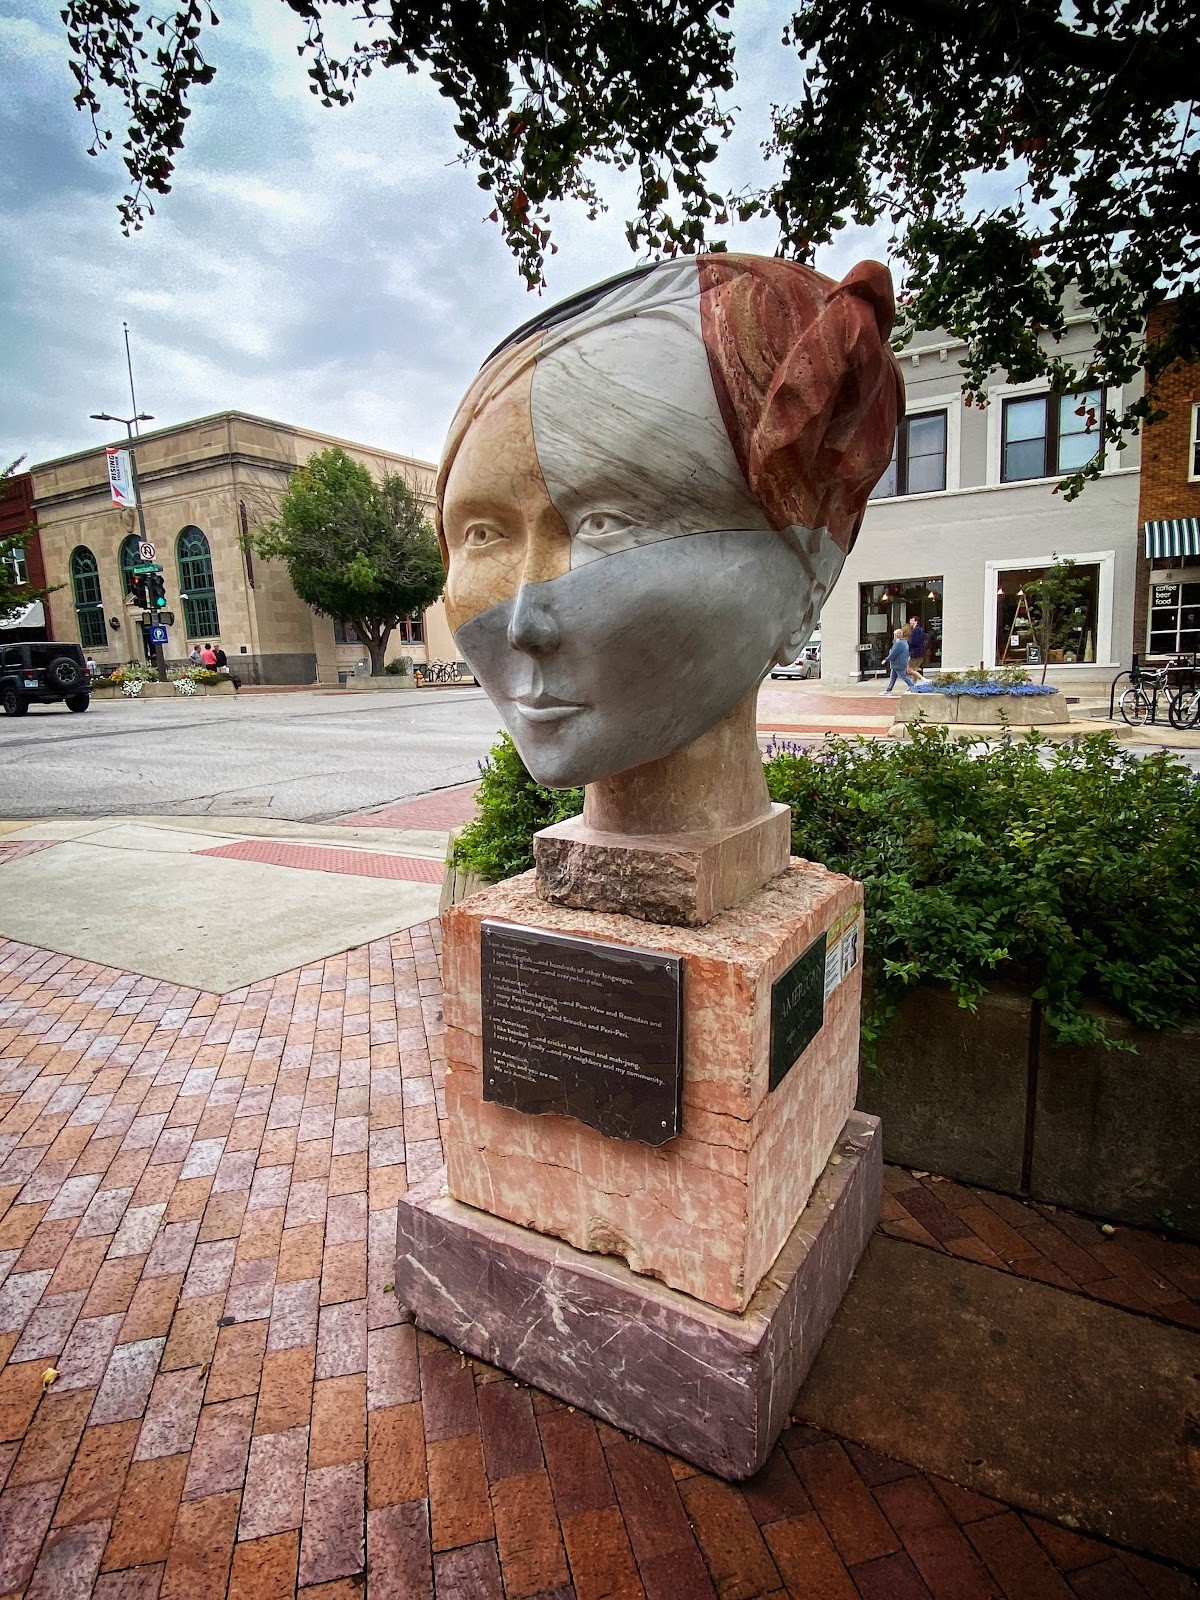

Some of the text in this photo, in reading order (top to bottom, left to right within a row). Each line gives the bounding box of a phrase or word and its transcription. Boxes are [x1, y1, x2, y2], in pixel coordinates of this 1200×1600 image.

[109, 455, 117, 481] RISING
[513, 954, 532, 962] English
[550, 961, 576, 972] hundreds
[602, 973, 634, 984] languages.
[520, 964, 539, 973] Europe
[557, 973, 590, 983] everywhere
[512, 996, 534, 1006] Festivals
[502, 1018, 529, 1030] American.
[576, 1002, 604, 1014] Pow-Wow
[619, 1013, 648, 1024] Ramadan
[563, 1017, 586, 1028] Sriracha
[600, 1026, 630, 1039] Peri-Peri.
[547, 1040, 566, 1049] cricket
[528, 1042, 545, 1052] family
[573, 1056, 602, 1067] neighbors
[616, 1067, 626, 1075] my
[627, 1071, 665, 1086] community.
